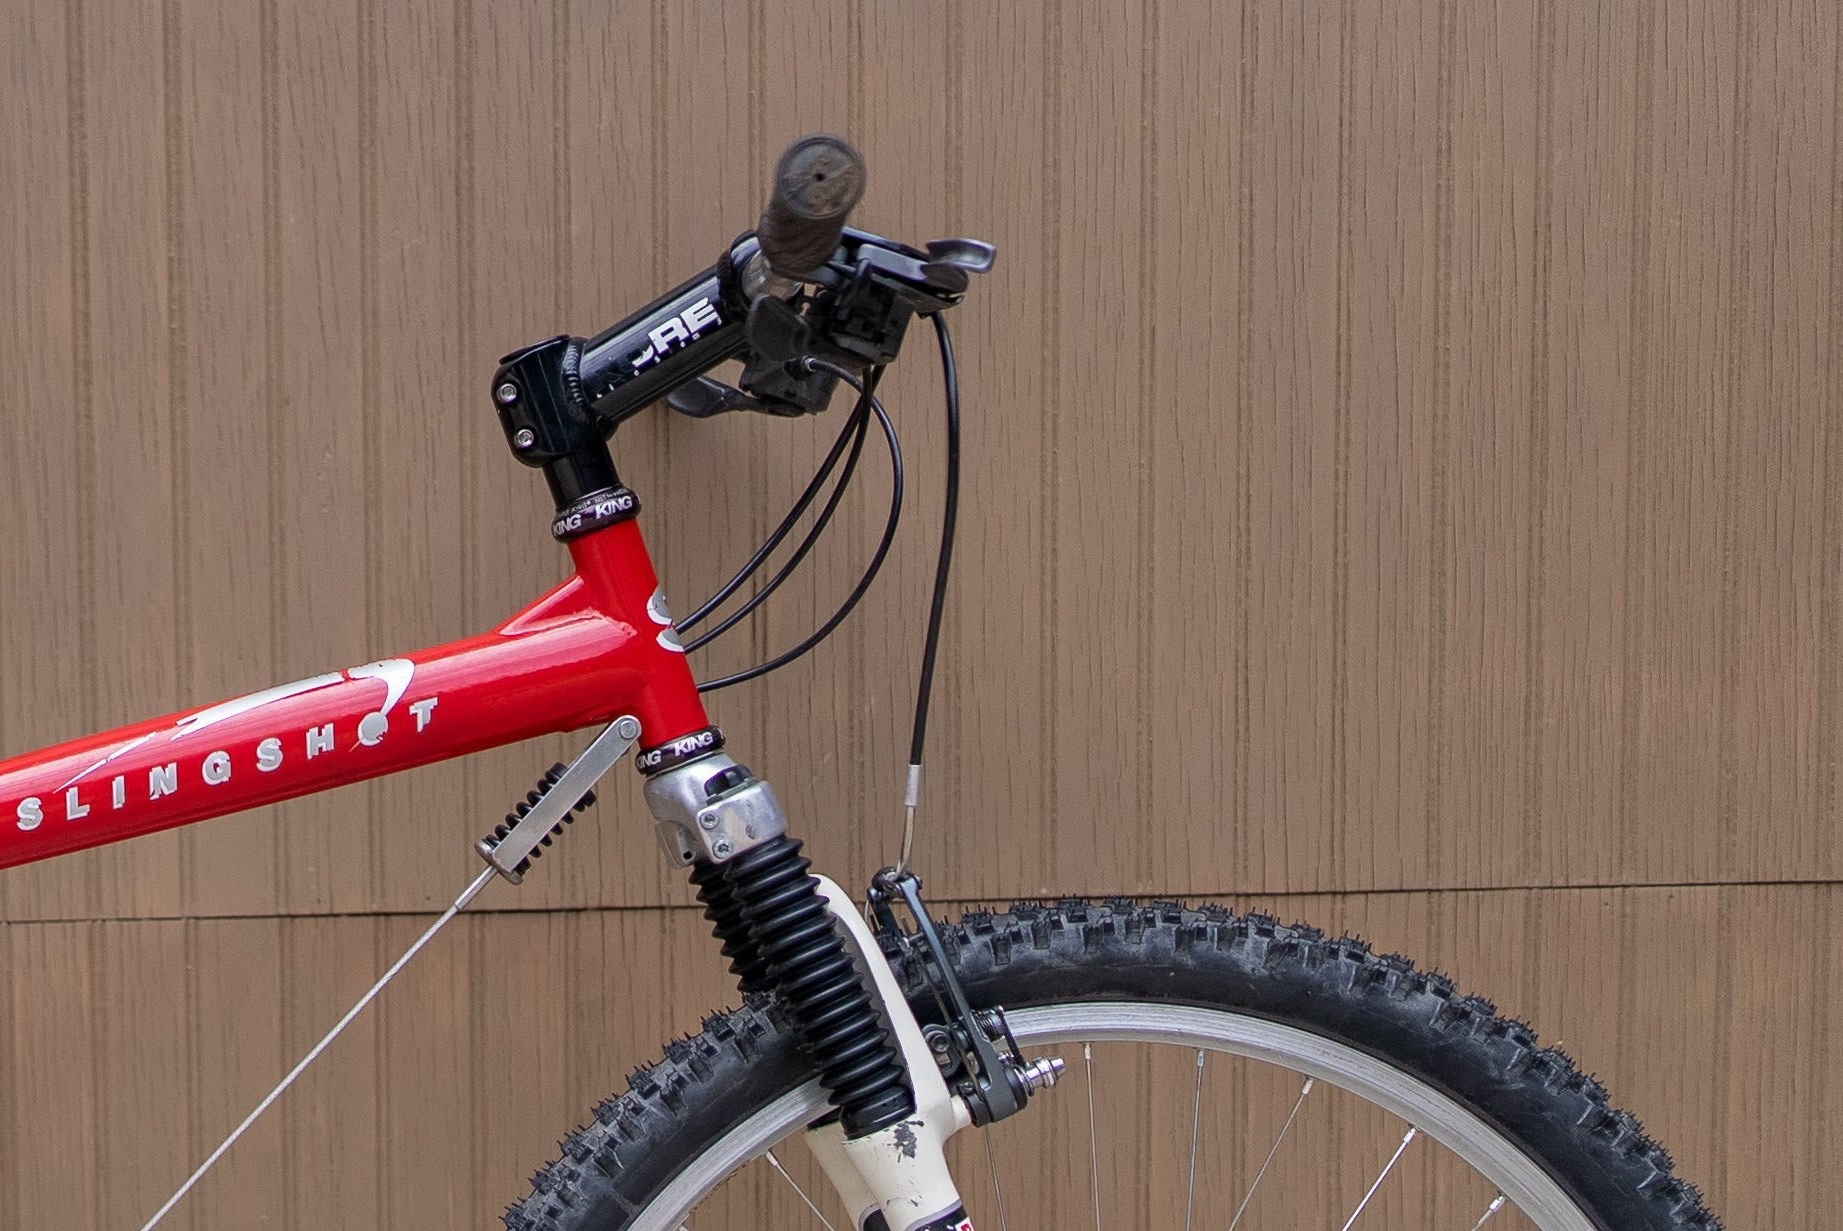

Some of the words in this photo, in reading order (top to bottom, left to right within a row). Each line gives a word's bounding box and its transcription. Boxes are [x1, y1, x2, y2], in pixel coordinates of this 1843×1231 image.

[594, 495, 633, 520] KING
[673, 731, 714, 757] KING
[16, 696, 439, 832] SLINGSHOT
